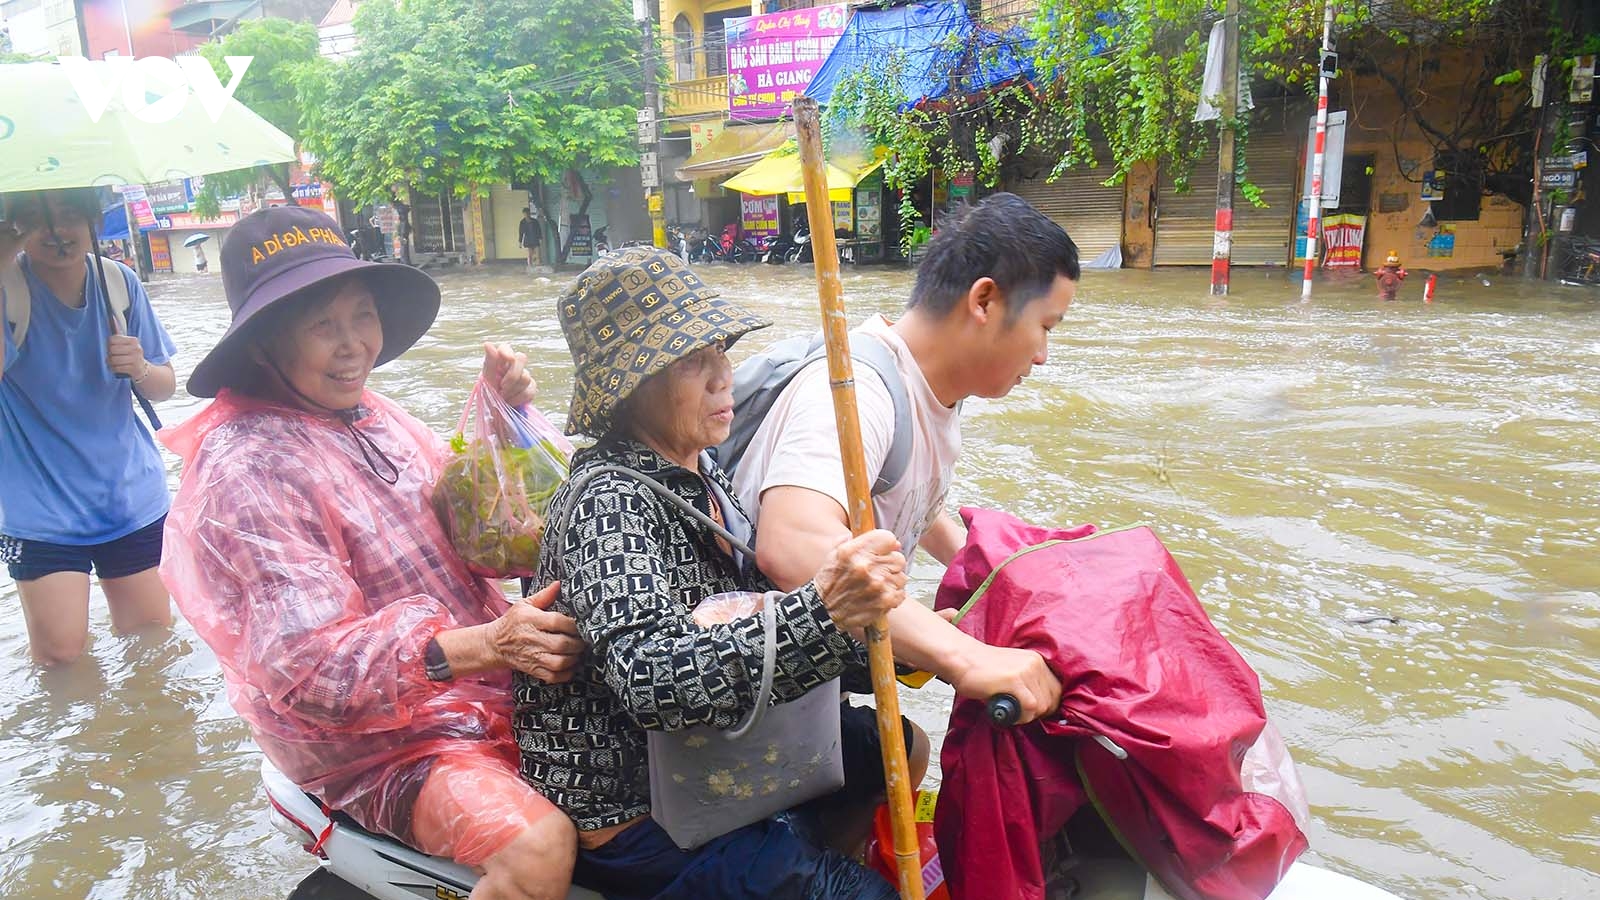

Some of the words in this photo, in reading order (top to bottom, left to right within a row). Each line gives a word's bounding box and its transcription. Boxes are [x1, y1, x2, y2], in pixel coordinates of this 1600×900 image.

[749, 38, 768, 68] SẢN
[768, 37, 793, 65] BÁNH
[794, 30, 819, 63] CUỐN
[757, 69, 774, 88] HÀ
[775, 69, 812, 86] GIANG
[282, 225, 310, 247] ĐÀ
[579, 503, 592, 520] L
[624, 496, 639, 513] L
[602, 516, 616, 532] L
[565, 532, 576, 550] L
[603, 537, 617, 552] G
[628, 537, 643, 552] L
[584, 547, 594, 563] L
[679, 546, 693, 562] L
[606, 559, 620, 575] L
[629, 557, 646, 570] G
[571, 577, 581, 594] L
[632, 576, 649, 591] L
[668, 573, 677, 588] L
[587, 588, 598, 605] L
[685, 590, 697, 606] L
[609, 601, 624, 619] L
[784, 596, 803, 615] L
[717, 641, 736, 660] L
[811, 645, 830, 662] L
[635, 666, 651, 681] L
[676, 657, 694, 677] L
[708, 677, 727, 695] L
[803, 674, 821, 688] L
[526, 687, 536, 703] L
[659, 691, 675, 706] L
[530, 715, 541, 729] L
[567, 717, 580, 731] L
[551, 736, 564, 750] L
[590, 735, 605, 748] L
[534, 764, 543, 779] L
